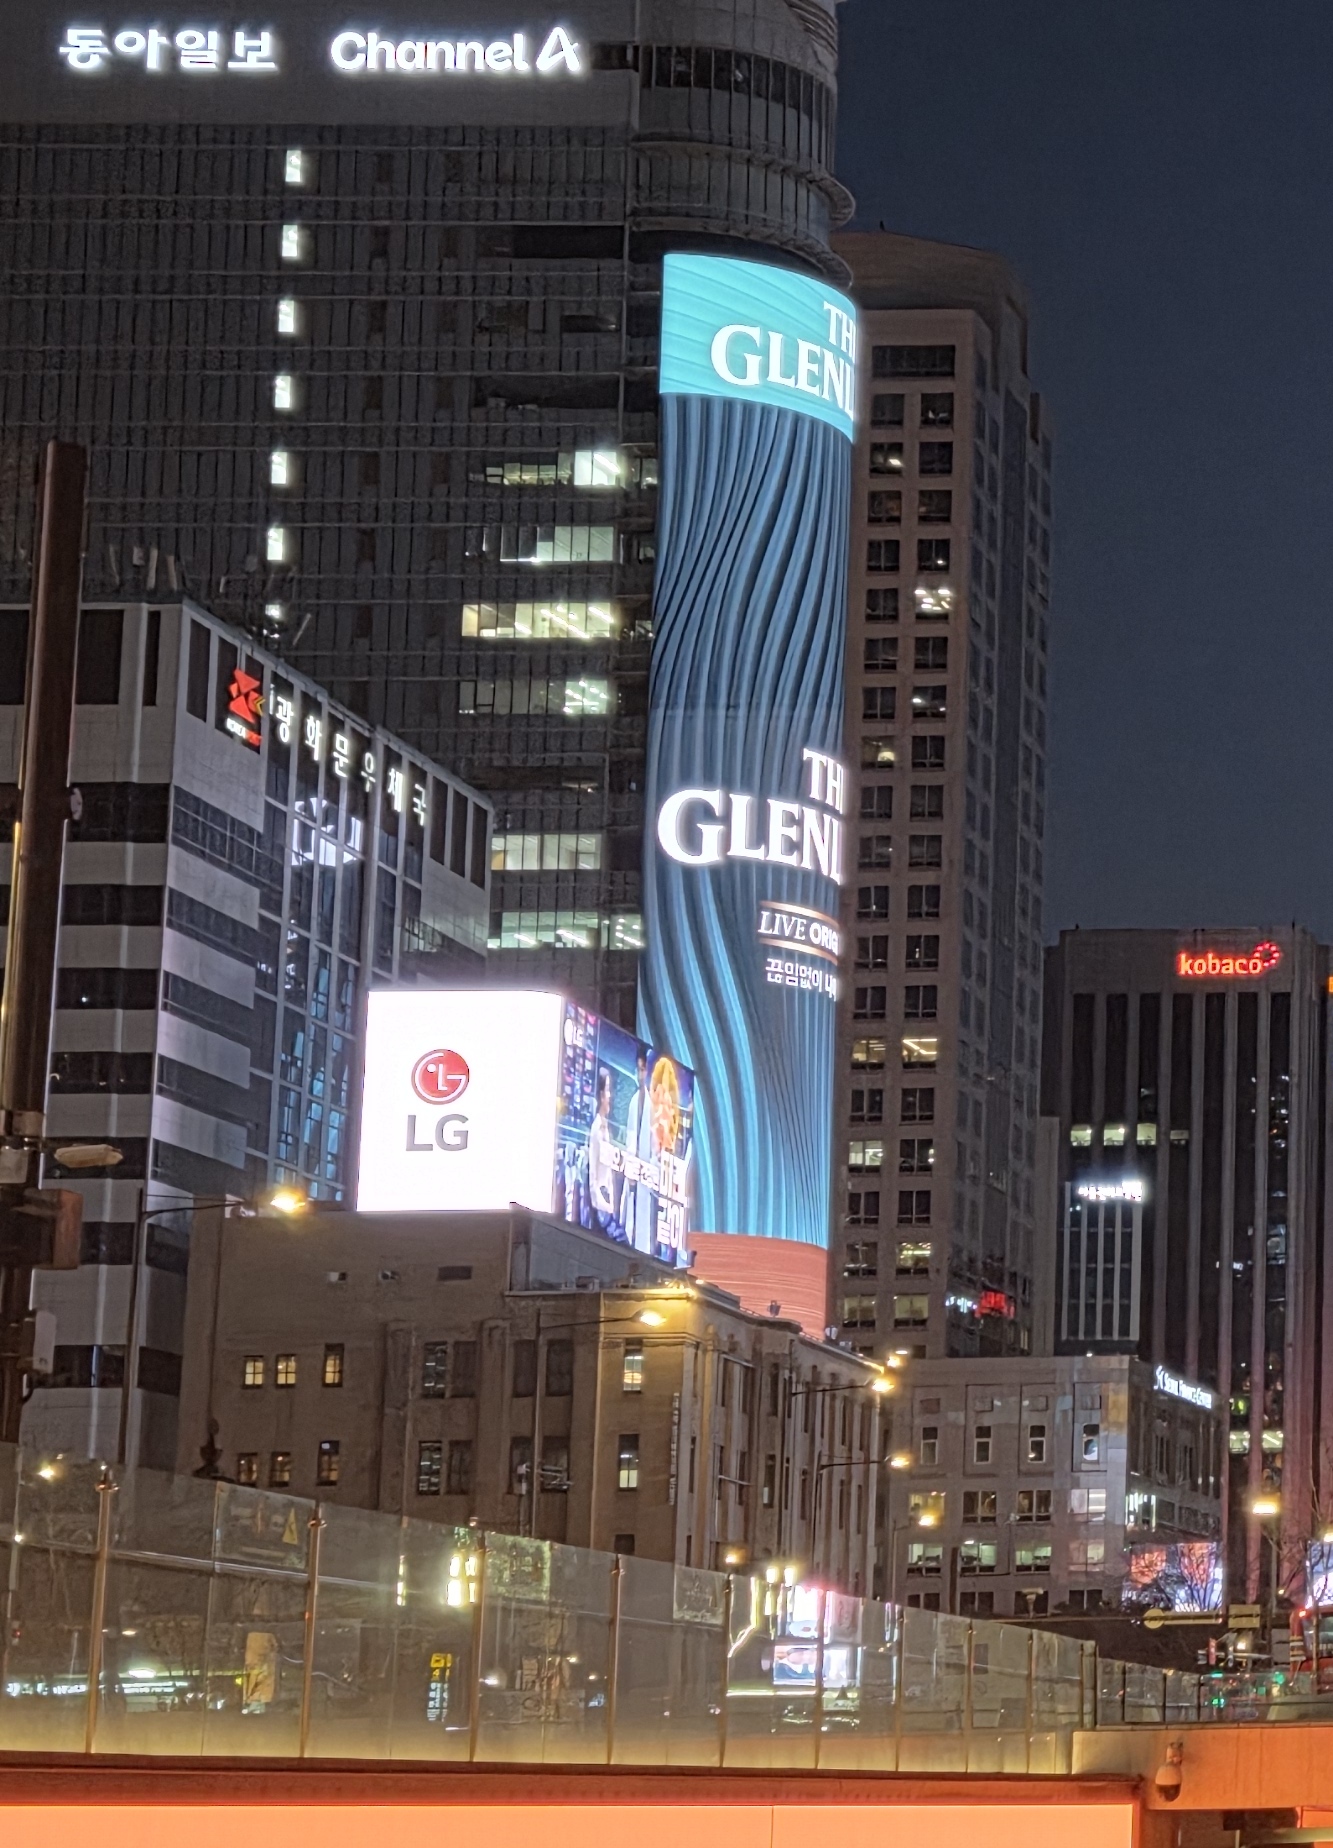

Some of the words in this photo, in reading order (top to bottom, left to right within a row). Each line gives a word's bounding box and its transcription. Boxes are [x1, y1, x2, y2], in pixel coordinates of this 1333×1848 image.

[59, 28, 278, 71] 동아일보
[330, 31, 530, 72] Channel
[535, 26, 581, 72] A
[275, 696, 427, 827] 광화문우체국
[803, 747, 844, 814] TH
[757, 911, 807, 941] LIVE
[1179, 952, 1263, 976] kobaco
[405, 1114, 469, 1152] LG
